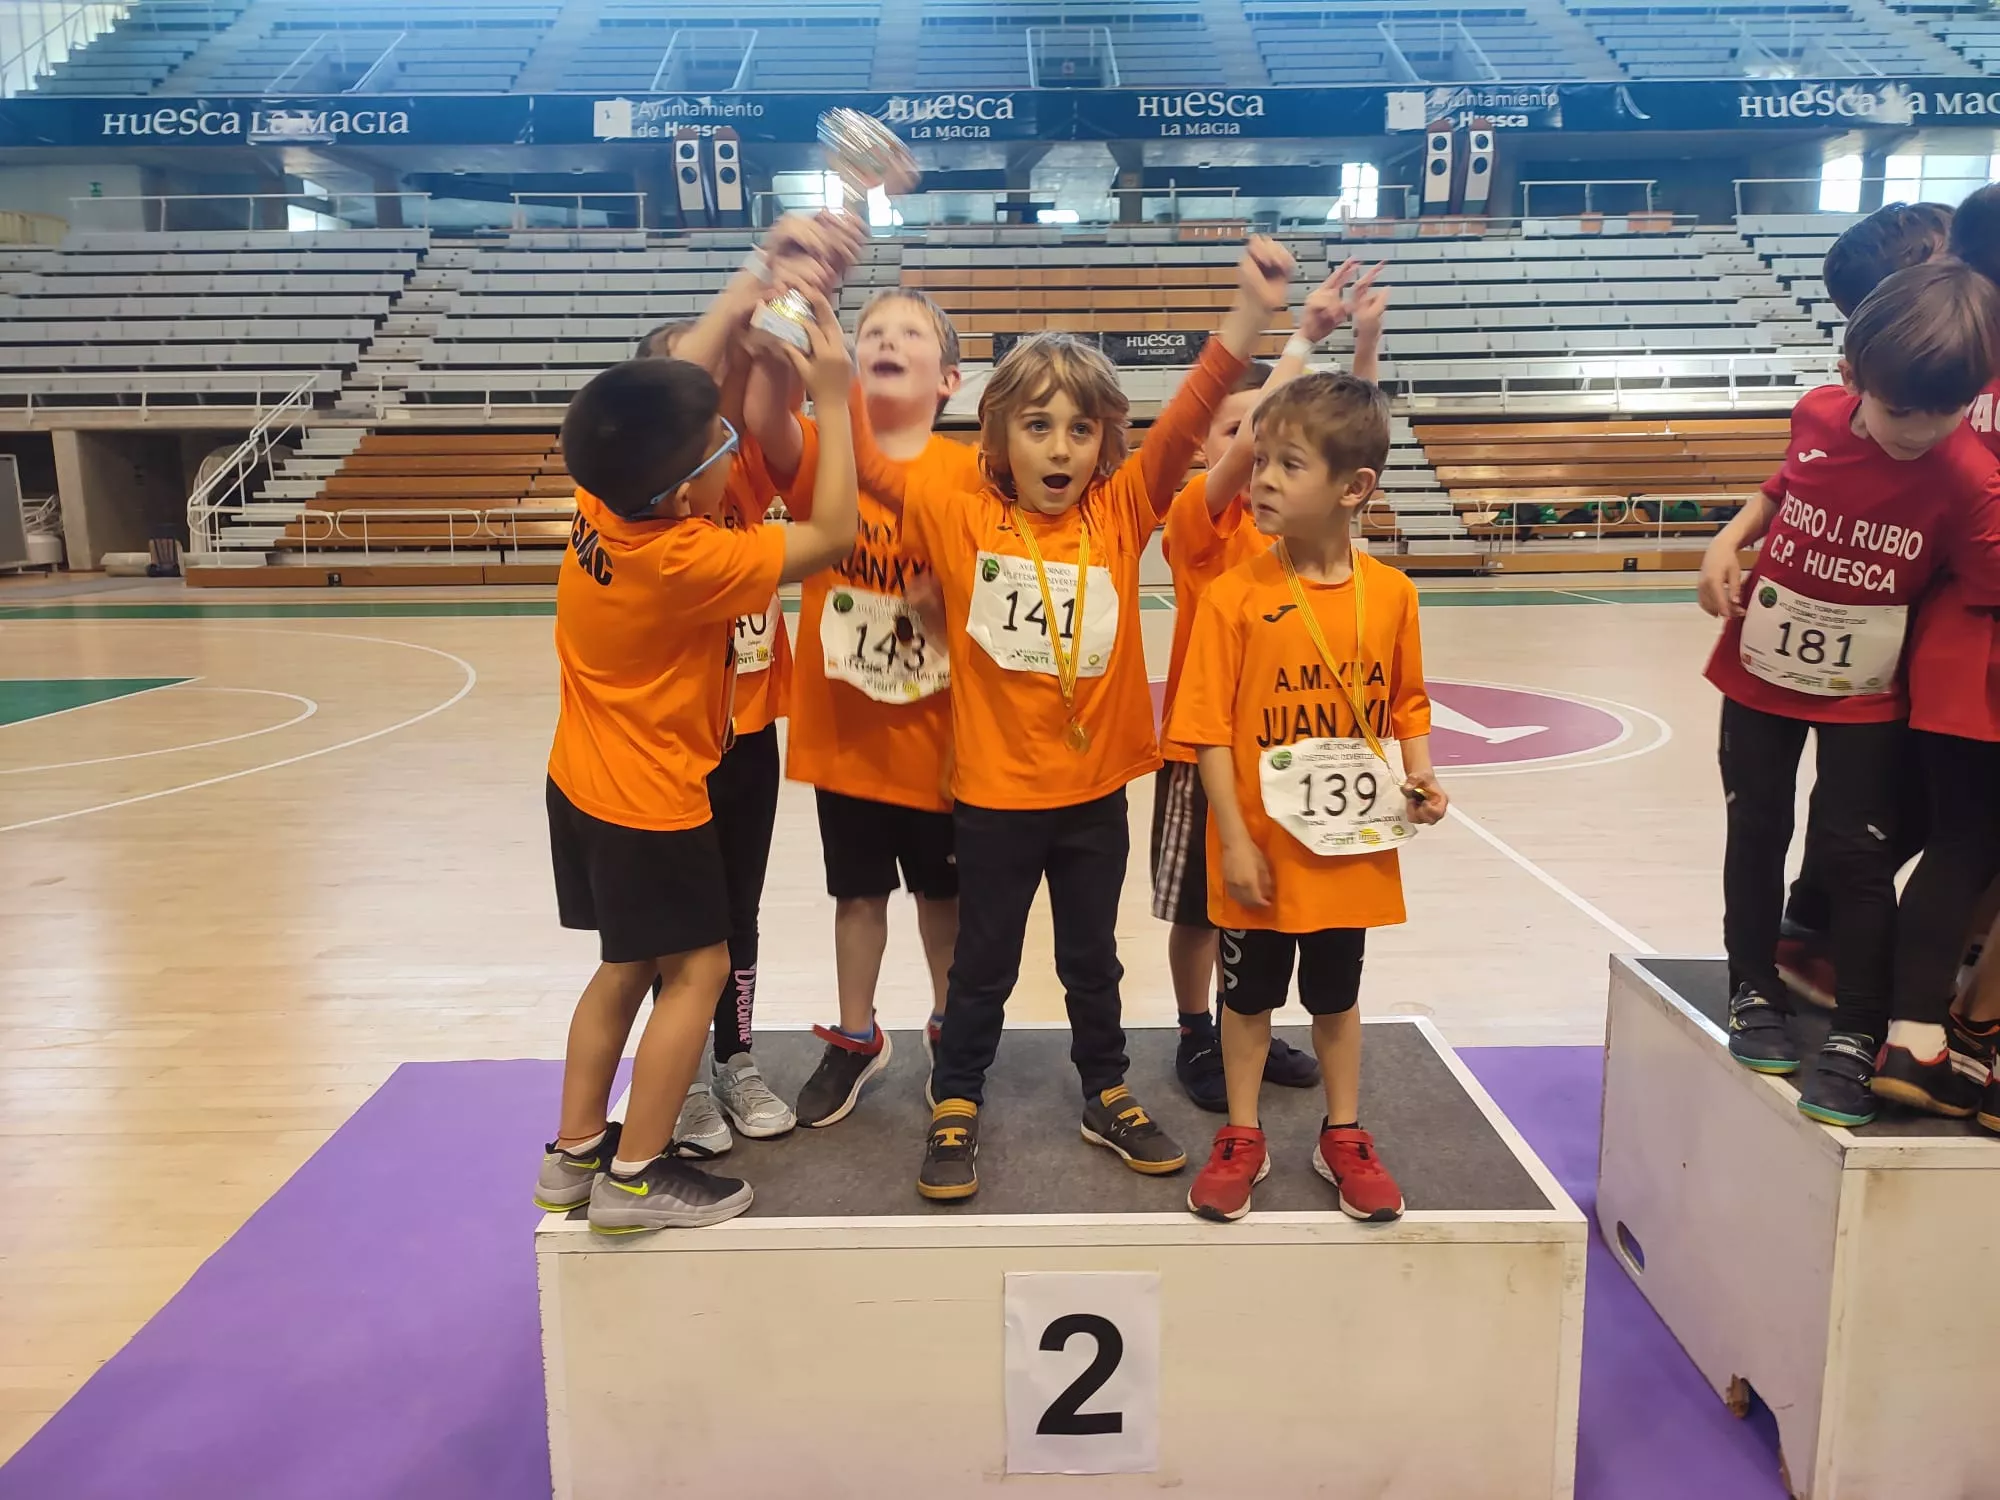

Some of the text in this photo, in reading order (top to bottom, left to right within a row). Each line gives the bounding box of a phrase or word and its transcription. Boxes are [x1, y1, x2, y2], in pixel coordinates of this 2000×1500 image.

[637, 121, 733, 138] de Hesc
[638, 101, 764, 121] Ayuntamiento
[1826, 515, 1844, 545] J.
[1850, 519, 1924, 561] RUBIO
[1802, 548, 1896, 594] HUESCA
[1002, 590, 1076, 639] 141
[1774, 621, 1854, 668] 181
[1300, 772, 1377, 816] 139
[1036, 1313, 1123, 1435] 2
